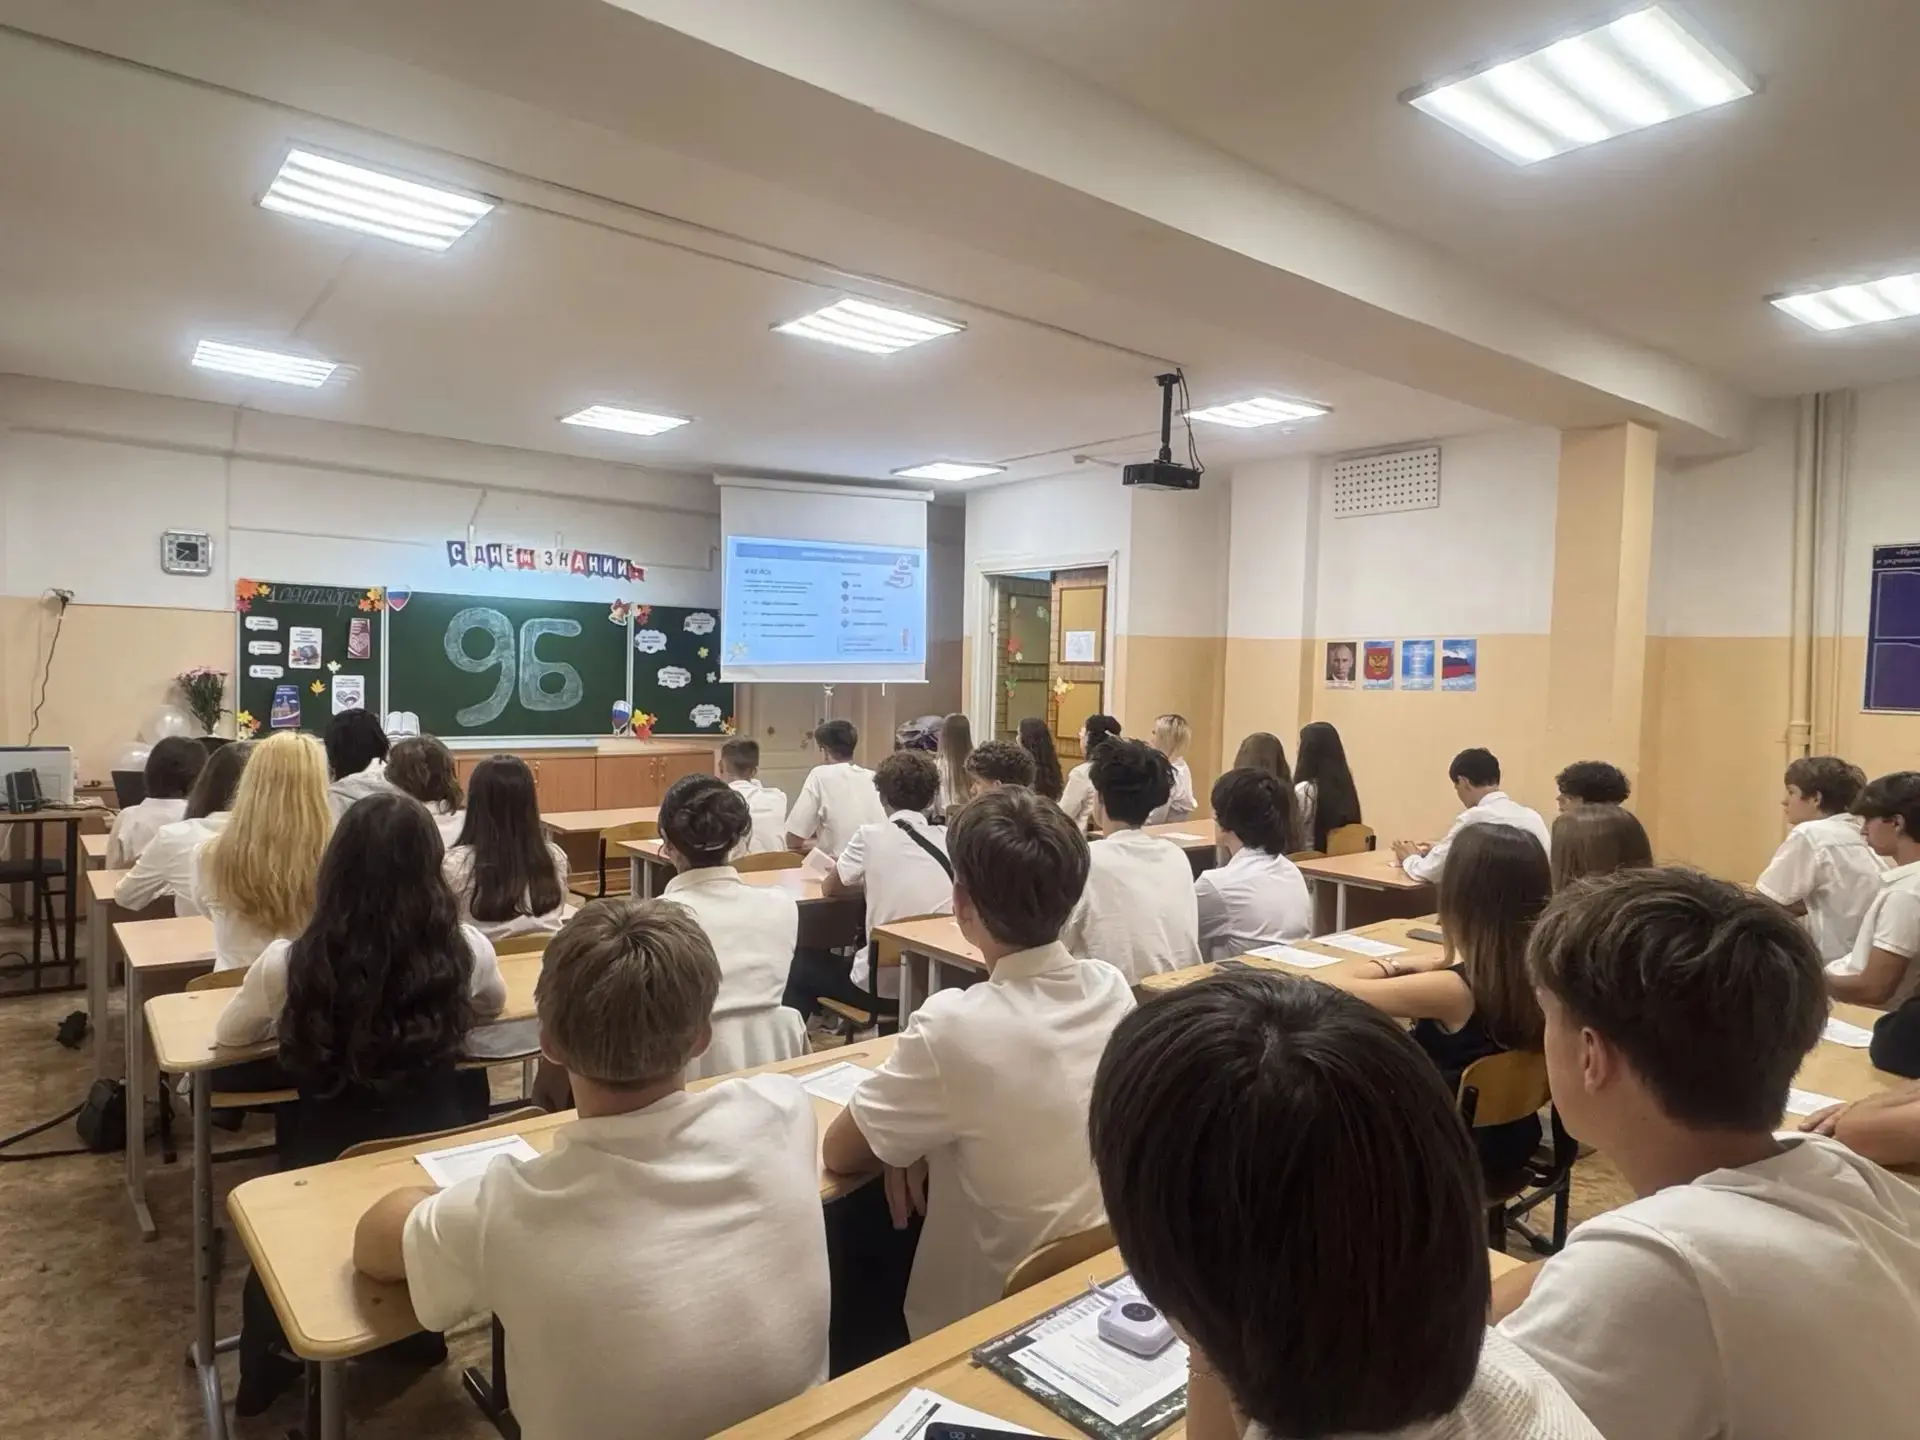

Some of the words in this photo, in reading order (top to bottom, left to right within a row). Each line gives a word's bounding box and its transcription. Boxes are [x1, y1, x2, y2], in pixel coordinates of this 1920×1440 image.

[451, 544, 462, 561] С
[475, 545, 532, 563] ДНЁМ
[444, 607, 583, 727] 9Б
